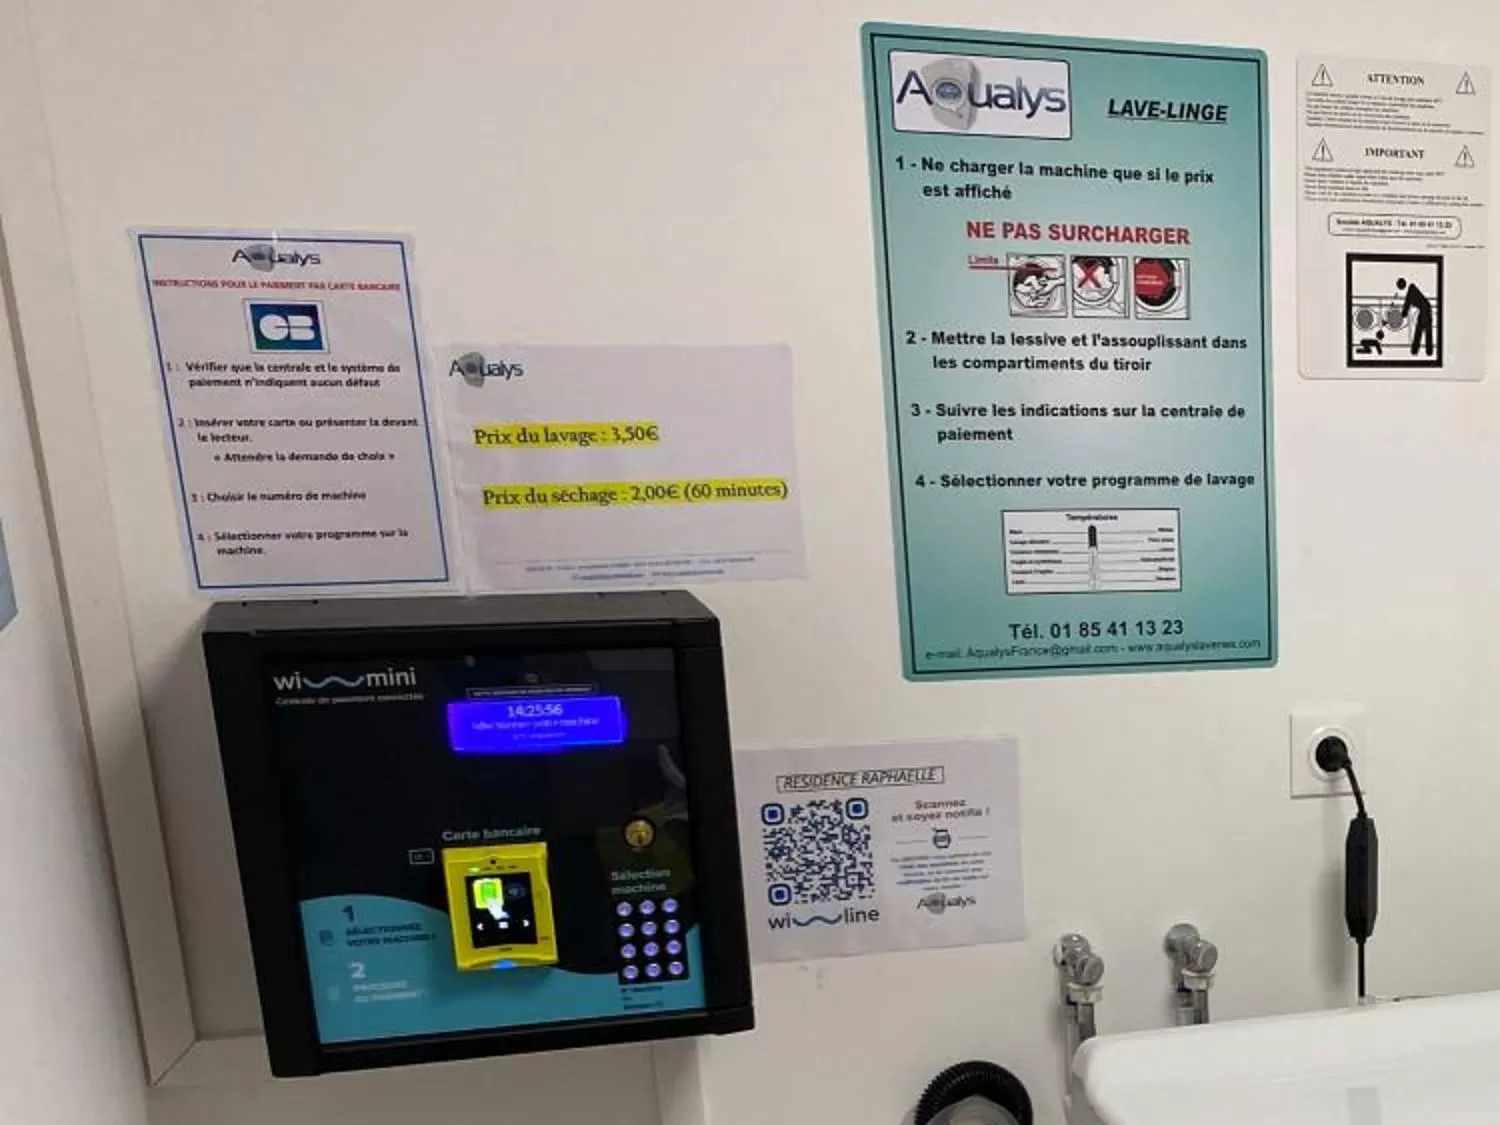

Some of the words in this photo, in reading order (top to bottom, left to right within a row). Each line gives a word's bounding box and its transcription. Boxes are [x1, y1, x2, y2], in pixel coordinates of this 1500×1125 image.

[1367, 74, 1425, 85] ATTENTION
[1108, 99, 1228, 122] LAVE-LINGE
[1365, 148, 1424, 159] IMPORTANT
[922, 158, 944, 172] Ne
[950, 159, 1014, 177] charger
[1019, 161, 1034, 175] la
[1039, 163, 1108, 180] machine
[1114, 168, 1142, 183] que
[1148, 167, 1161, 181] si
[1165, 168, 1180, 182] le
[1184, 169, 1214, 185] prix
[923, 185, 949, 198] est
[955, 185, 1012, 200] affiché
[967, 222, 995, 239] NE
[1002, 223, 1041, 241] PAS
[1049, 224, 1190, 245] SURCHARGER
[932, 332, 986, 346] Mettre
[991, 333, 1005, 346] la
[1010, 333, 1066, 346] lessive
[1071, 334, 1088, 347] et
[1092, 333, 1207, 350] l'assouplissant
[1212, 336, 1247, 349] dans
[186, 362, 228, 372] Vérifier
[231, 365, 250, 374] que
[268, 363, 311, 373] centrale
[341, 363, 384, 374] système
[933, 357, 957, 369] les
[962, 357, 1084, 373] compartiments
[1089, 359, 1109, 371] du
[1114, 358, 1152, 371] tiroir
[189, 378, 241, 388] paiement
[245, 377, 306, 388] n'indiquent
[936, 404, 987, 417] Suivre
[992, 404, 1017, 417] les
[1021, 404, 1109, 417] indications
[1113, 407, 1137, 417] sur
[1141, 405, 1156, 417] la
[1161, 405, 1223, 418] centrale
[1228, 405, 1245, 418] de
[381, 418, 418, 427] devant
[474, 428, 511, 445] Prix
[517, 427, 539, 443] du
[544, 425, 598, 446] lavage
[611, 425, 659, 444] 3,50€
[937, 428, 1013, 443] paiement
[941, 474, 1042, 488] Sélectionner
[1047, 475, 1087, 487] votre
[1092, 474, 1179, 490] programme
[1184, 474, 1202, 486] de
[1207, 474, 1255, 489] lavage
[322, 491, 366, 500] machine
[483, 488, 520, 505] Prix
[526, 487, 547, 504] du
[551, 486, 617, 507] séchage
[631, 484, 680, 502] 2,00€
[684, 482, 711, 502] (60
[715, 480, 787, 499] minutes)
[316, 530, 376, 541] programme
[1009, 623, 1044, 639] Tél.
[1051, 623, 1071, 638] 01
[1079, 622, 1101, 638] 85
[1107, 621, 1127, 637] 41
[1136, 621, 1156, 636] 13
[1162, 620, 1183, 635] 23
[784, 773, 856, 789] RESIDENCE
[861, 767, 936, 785] RAPHAELLE
[441, 829, 480, 841] Carte
[483, 826, 542, 839] bancaire
[350, 961, 366, 978] 2
